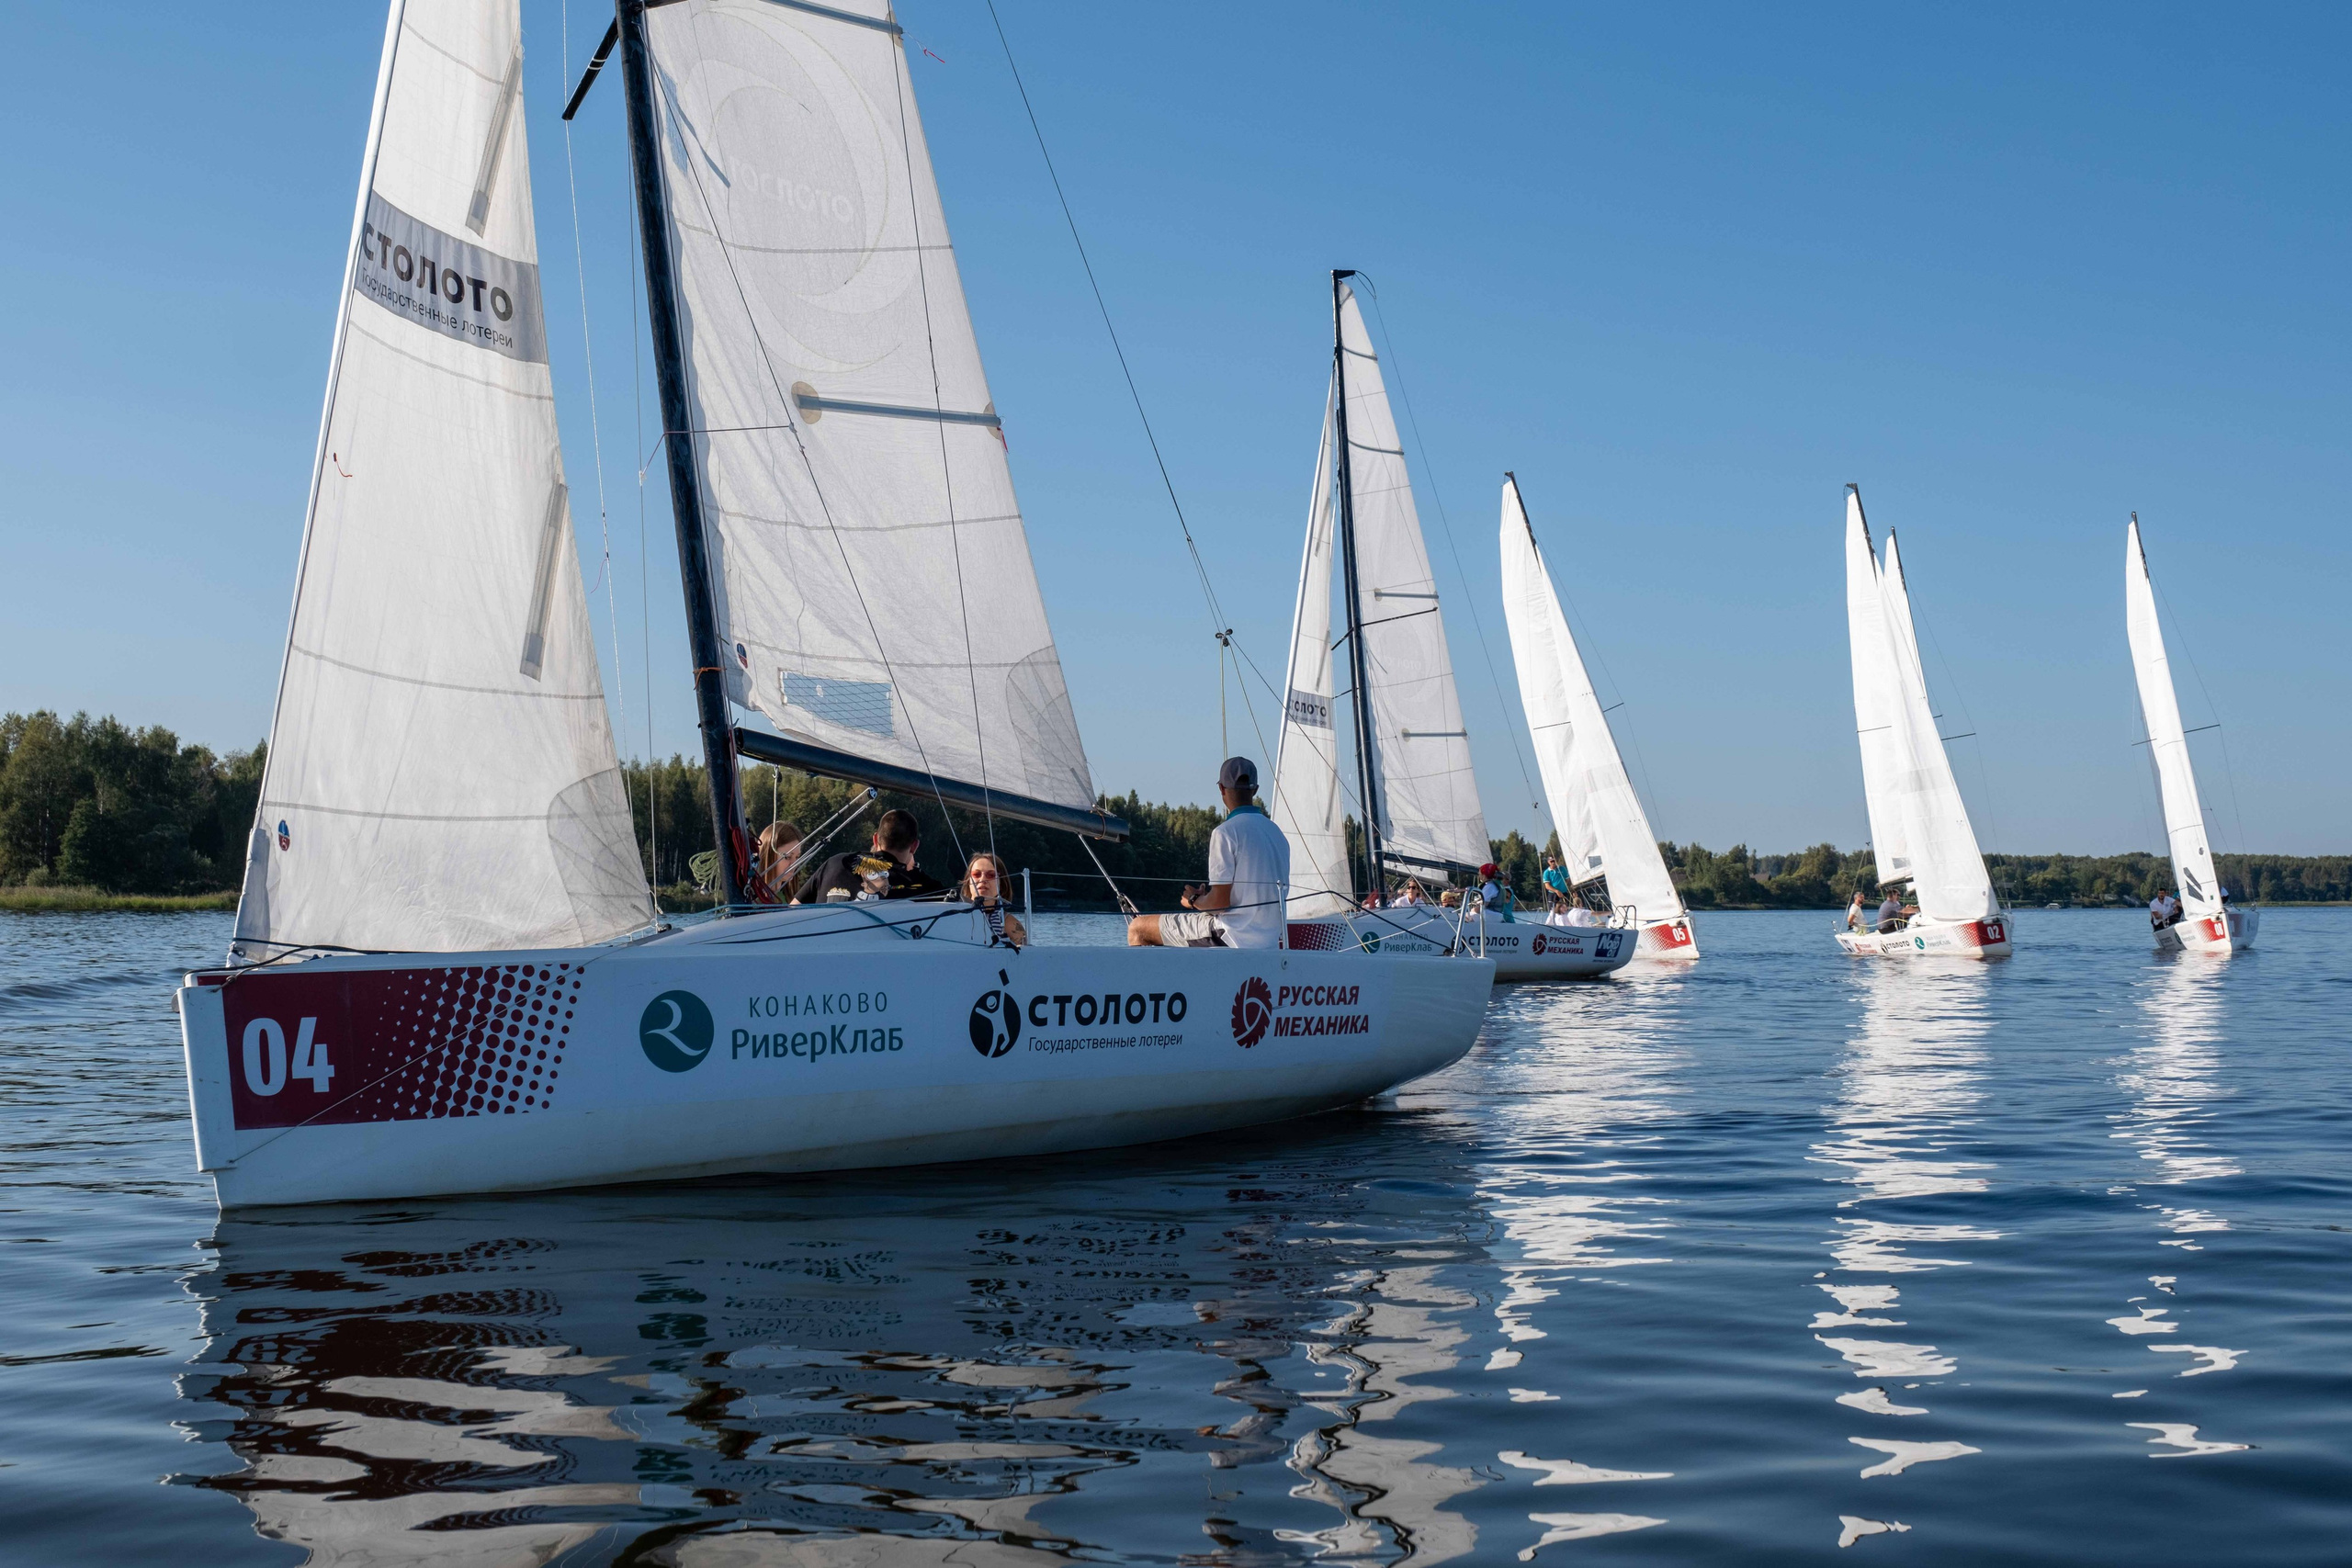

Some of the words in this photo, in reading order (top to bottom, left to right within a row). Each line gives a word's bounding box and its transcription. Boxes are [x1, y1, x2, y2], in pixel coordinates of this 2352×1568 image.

[362, 267, 458, 329] Государственные
[461, 320, 514, 349] лотереи
[1549, 936, 1580, 945] РУССКАЯ
[1672, 928, 1686, 942] 05
[1987, 925, 2000, 939] 02
[1384, 942, 1432, 953] РиверКлаб
[1547, 946, 1584, 955] МЕХАНИКА
[748, 991, 888, 1018] КОНАКОВО
[1278, 986, 1361, 1007] РУССКАЯ
[1027, 991, 1188, 1027] СТОЛОТО
[1273, 1014, 1370, 1038] МЕХАНИКА
[731, 1021, 904, 1064] РиверКлаб
[1028, 1034, 1136, 1055] Государственные
[1138, 1033, 1183, 1049] лотереи
[243, 1016, 335, 1097] 04
